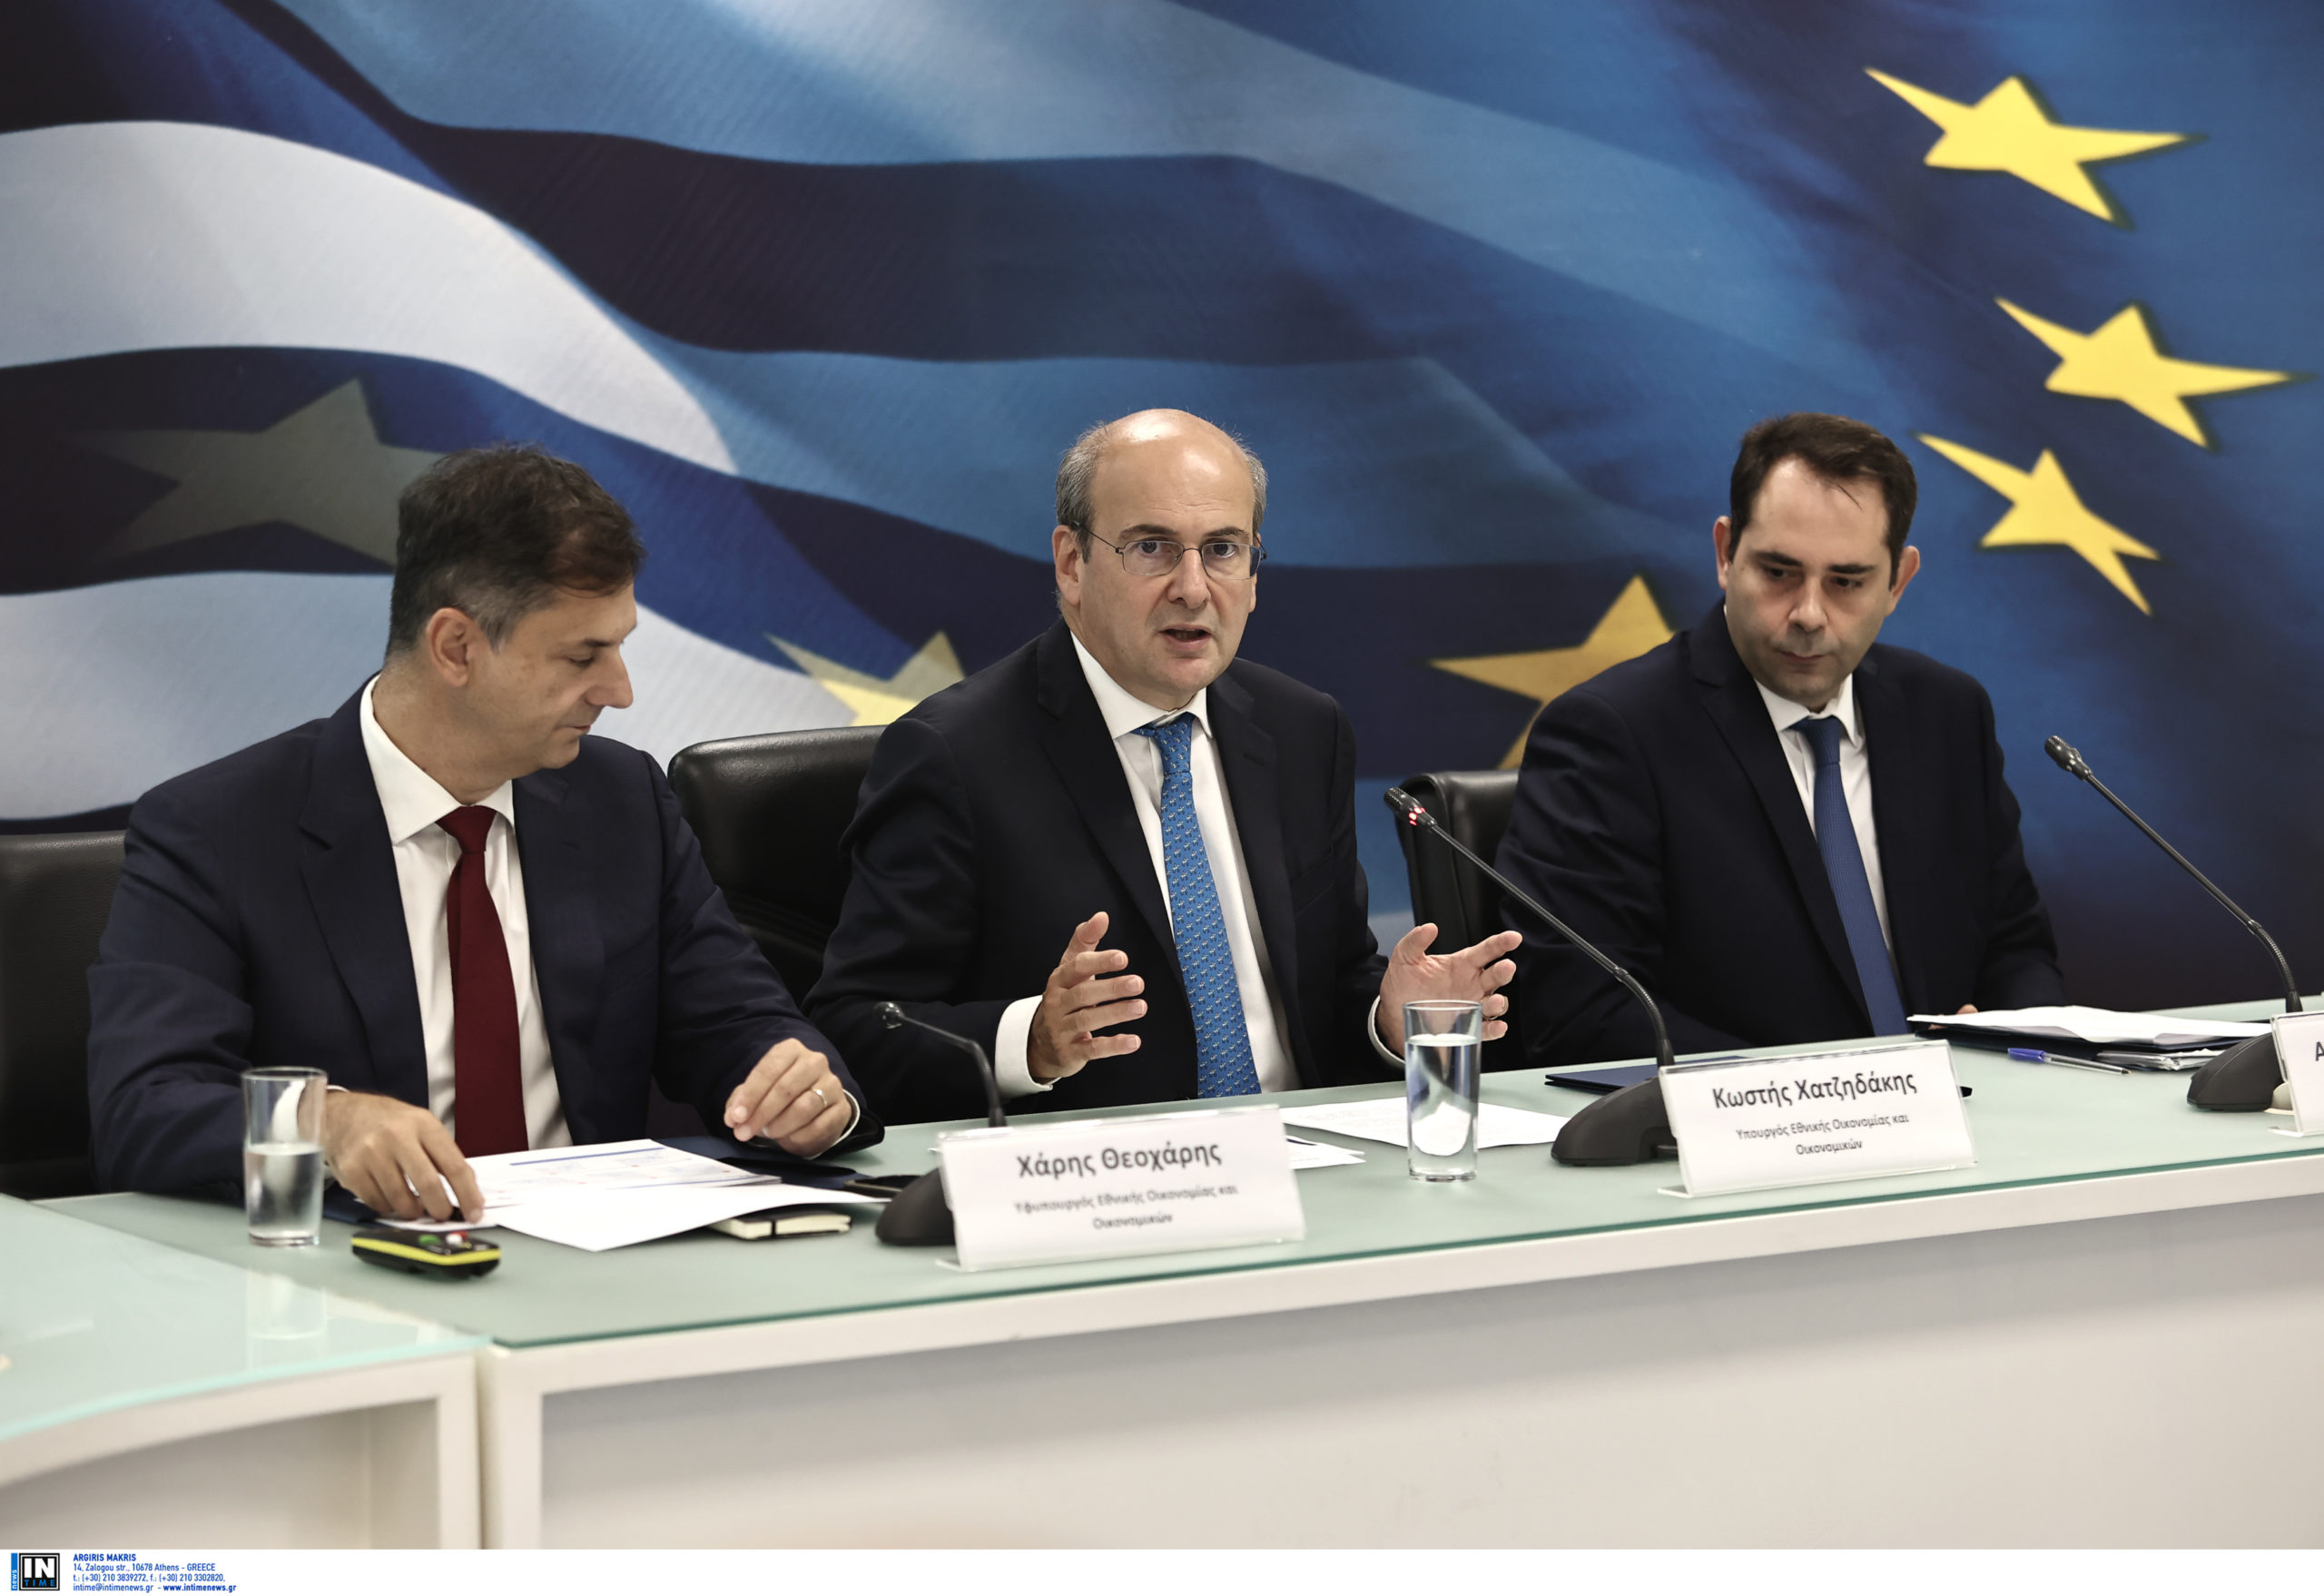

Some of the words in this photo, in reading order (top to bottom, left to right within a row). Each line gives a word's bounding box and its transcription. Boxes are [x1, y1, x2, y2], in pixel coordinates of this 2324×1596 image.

[1711, 1079, 1793, 1108] Κωστής
[1794, 1071, 1917, 1101] Χατζηδάκης
[1735, 1126, 1790, 1140] Υπουργός
[1790, 1121, 1832, 1135] Εθνικής
[1832, 1115, 1891, 1130] Οικονομίας
[1892, 1114, 1910, 1124] και
[1017, 1152, 1096, 1179] Χάρης
[1101, 1141, 1223, 1171] Θεοχάρης
[1795, 1140, 1864, 1156] Οικονομικών
